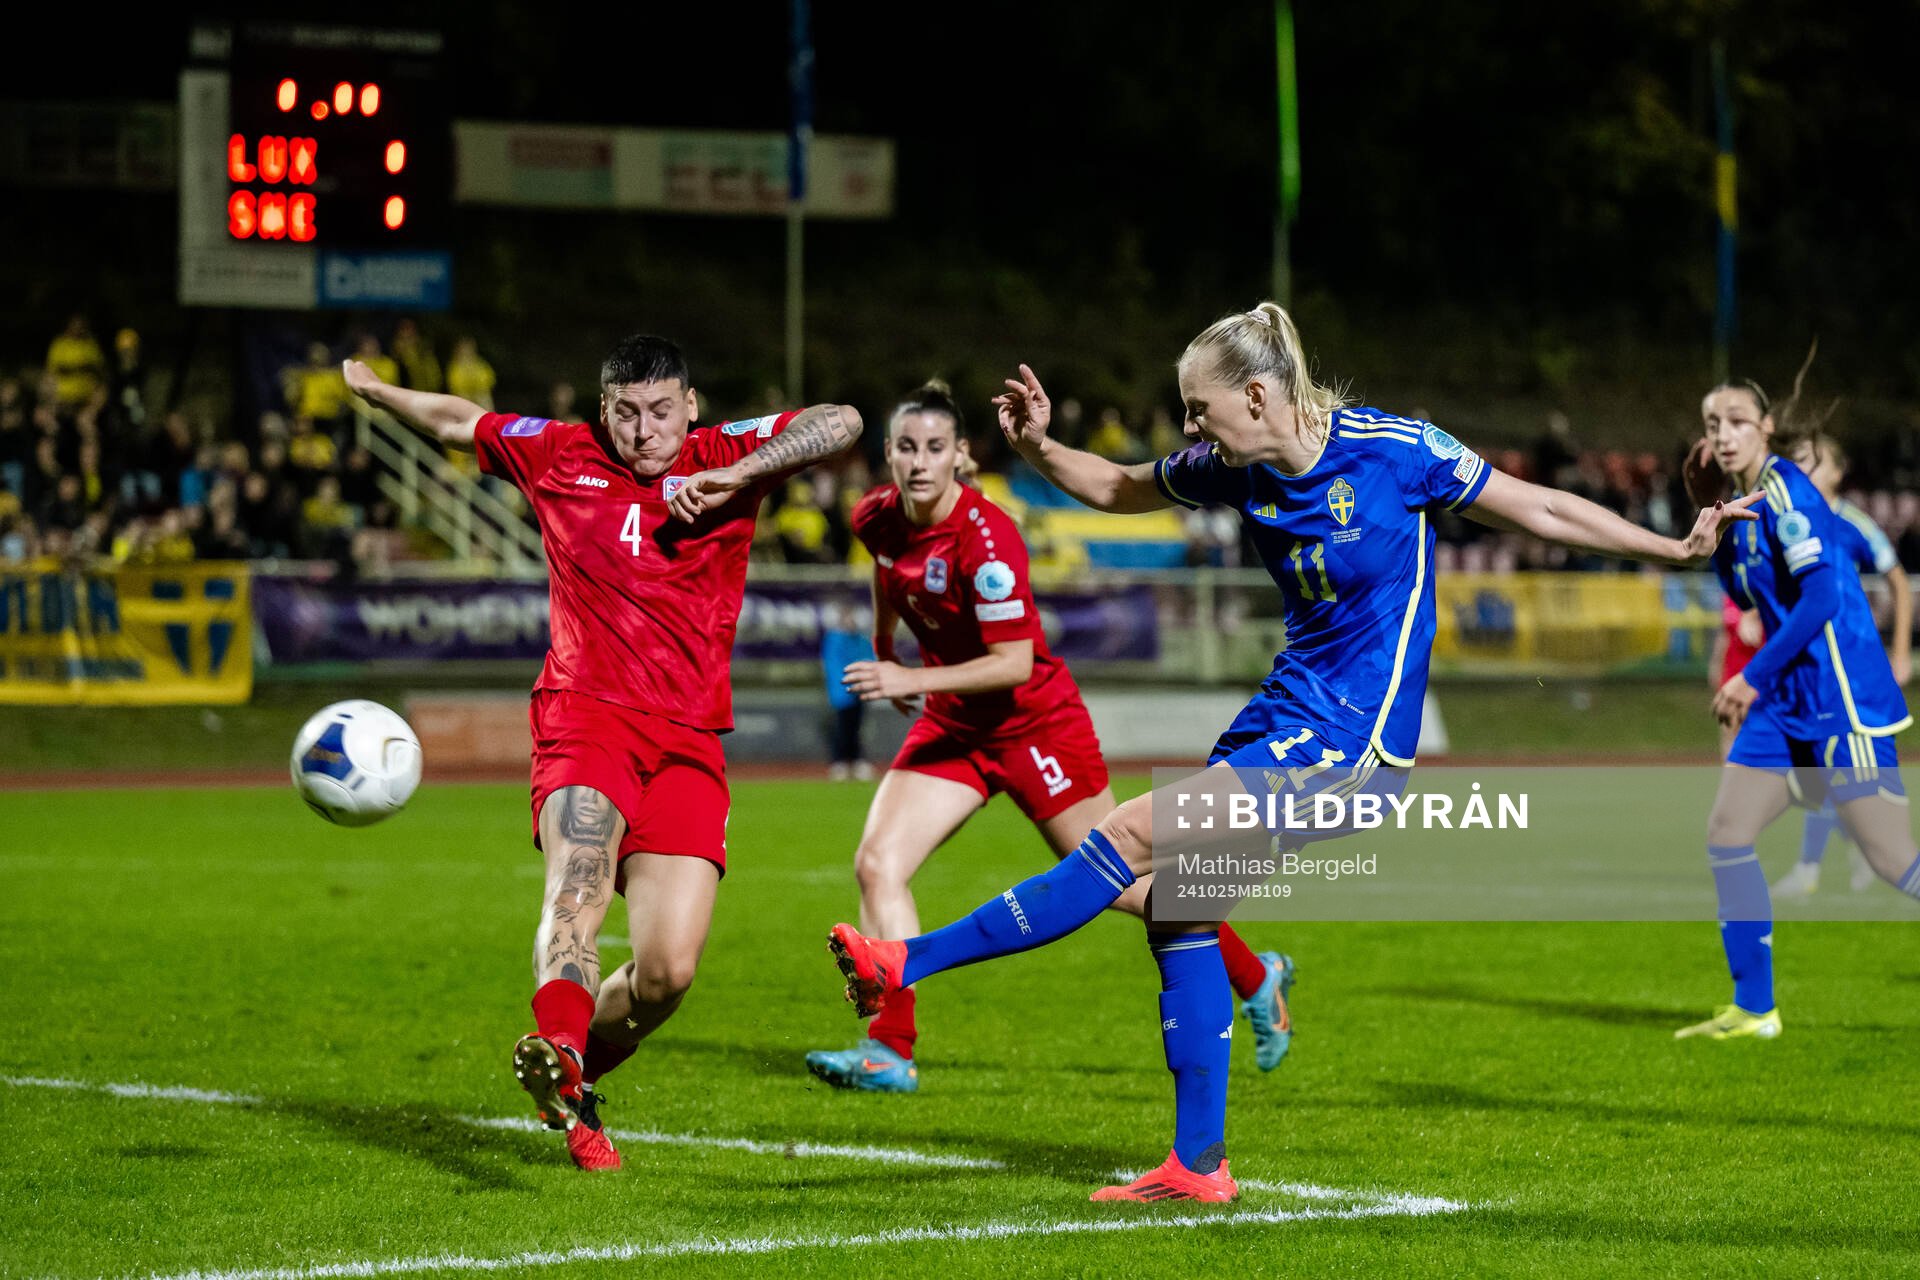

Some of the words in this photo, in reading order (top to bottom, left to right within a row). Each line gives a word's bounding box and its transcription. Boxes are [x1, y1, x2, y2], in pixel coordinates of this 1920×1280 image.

[228, 133, 318, 185] LUX
[575, 475, 609, 488] JAKO
[619, 503, 642, 556] 4
[1289, 541, 1338, 602] 11
[1029, 746, 1064, 787] 5
